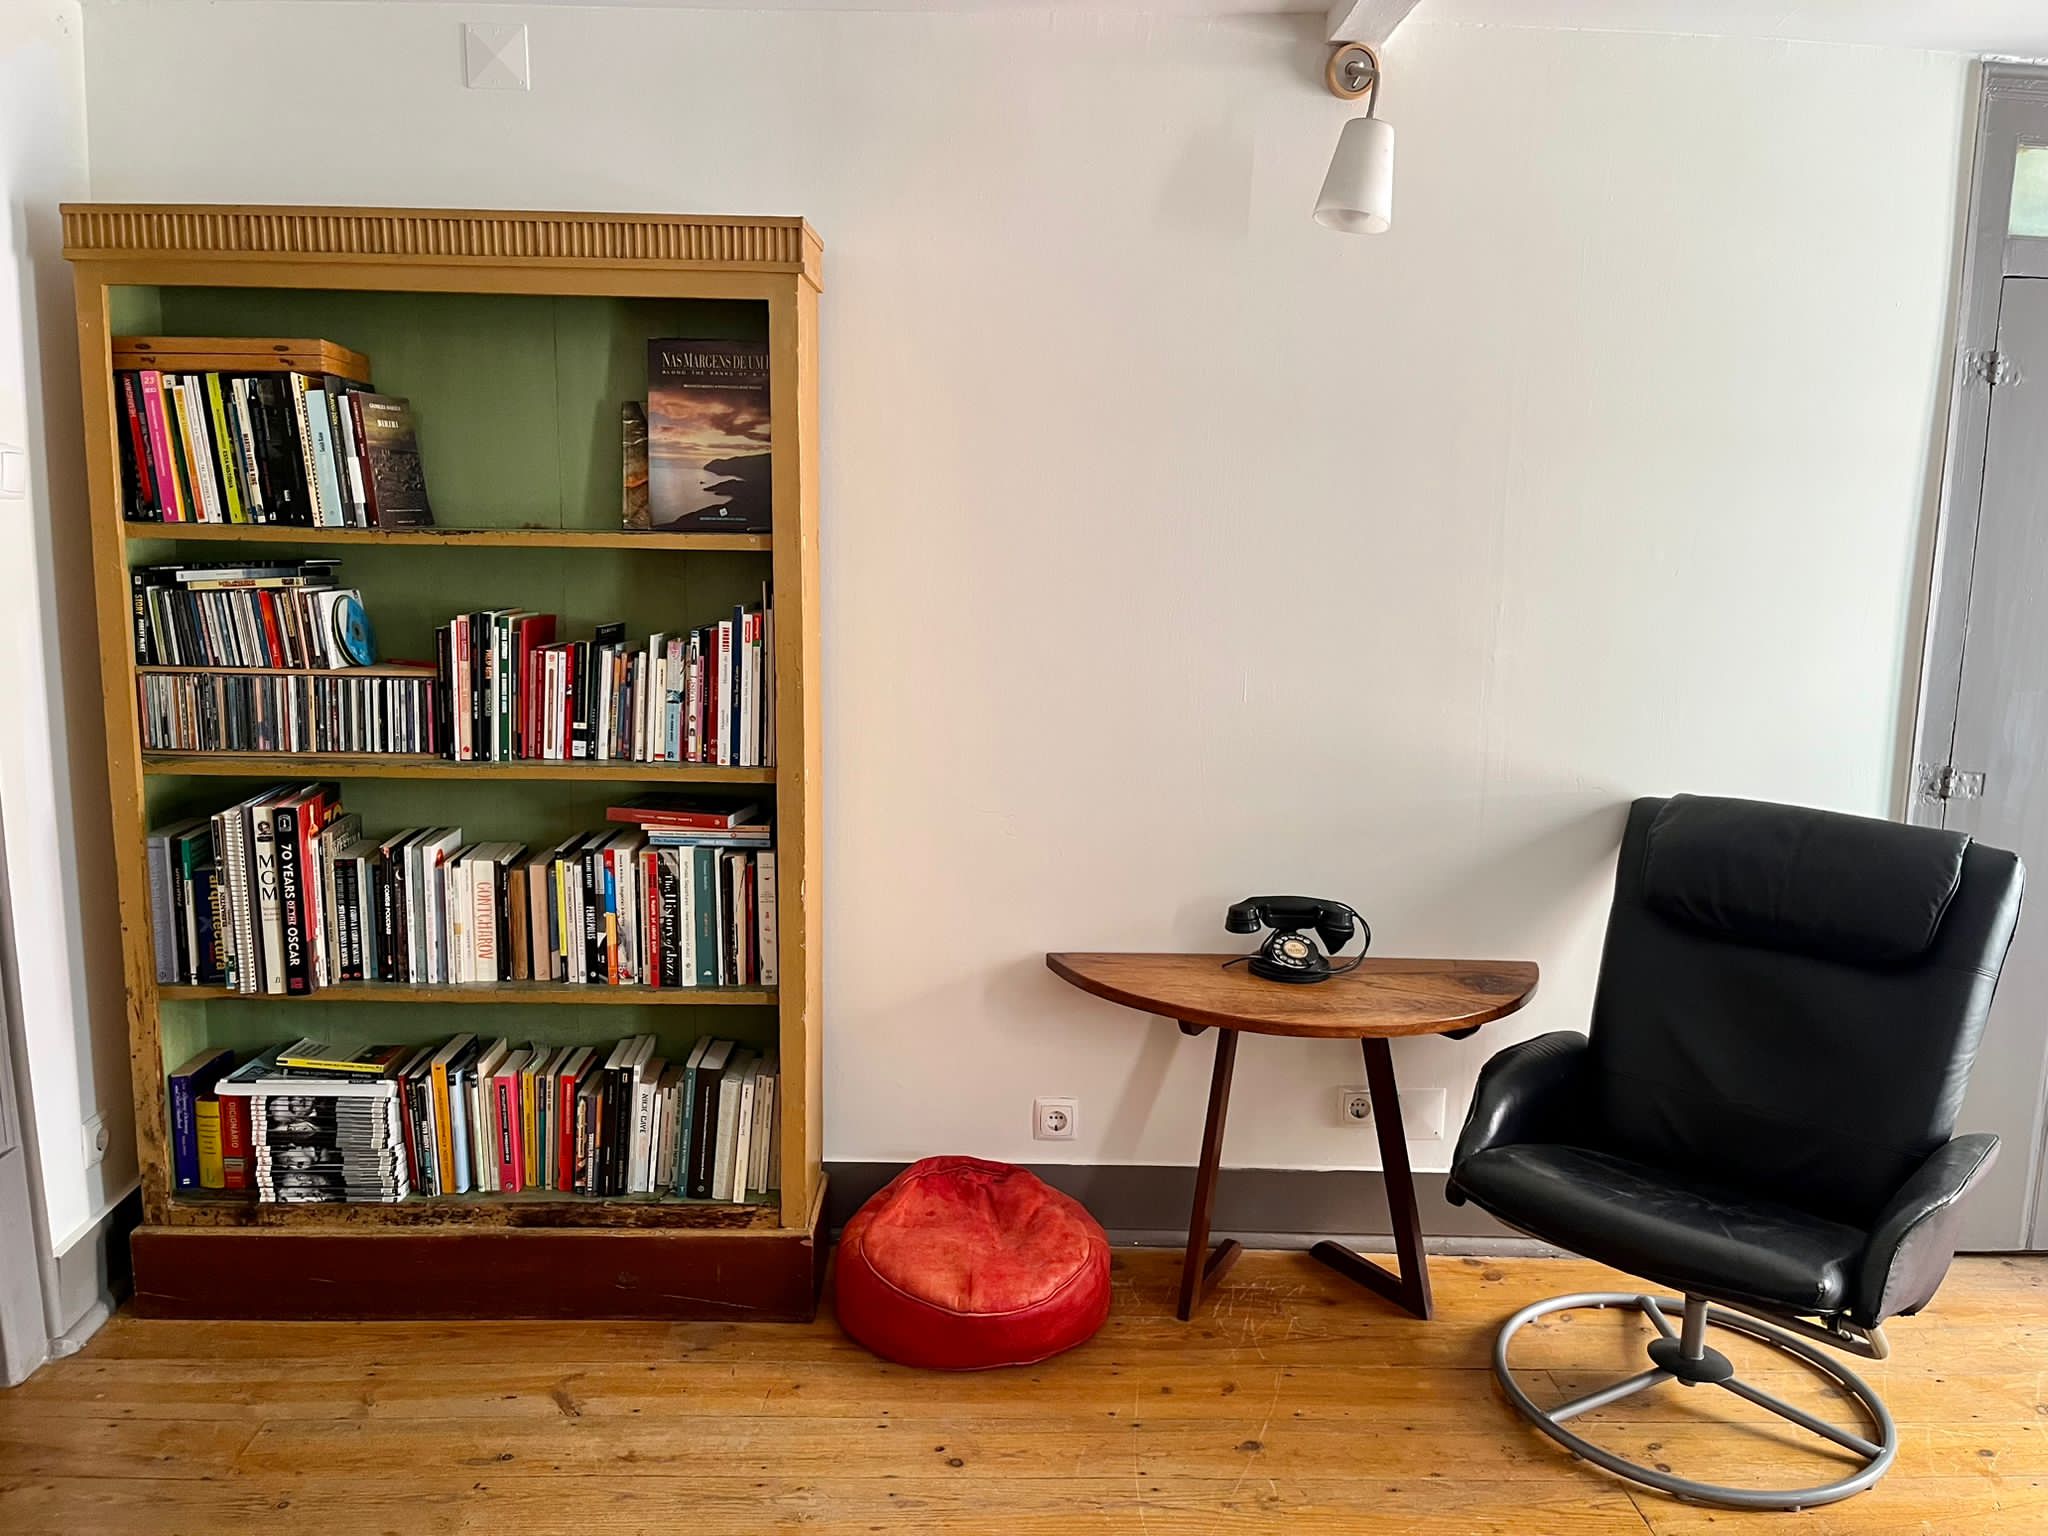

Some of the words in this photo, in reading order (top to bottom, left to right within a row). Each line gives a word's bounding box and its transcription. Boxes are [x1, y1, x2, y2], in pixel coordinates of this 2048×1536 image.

[662, 351, 682, 367] NAS
[683, 352, 732, 369] MARGENS
[733, 354, 747, 369] DE
[243, 433, 251, 453] MARTIN
[134, 594, 144, 615] STORY
[280, 843, 292, 860] 70
[282, 862, 295, 899] YEARS
[664, 873, 674, 892] The
[664, 893, 677, 936] History
[287, 927, 300, 966] OSCAR
[663, 937, 675, 951] of
[665, 950, 678, 976] Jazz
[640, 1093, 649, 1112] NICK
[228, 1101, 239, 1149] DICIONÁRIO
[639, 1115, 648, 1134] CAVE
